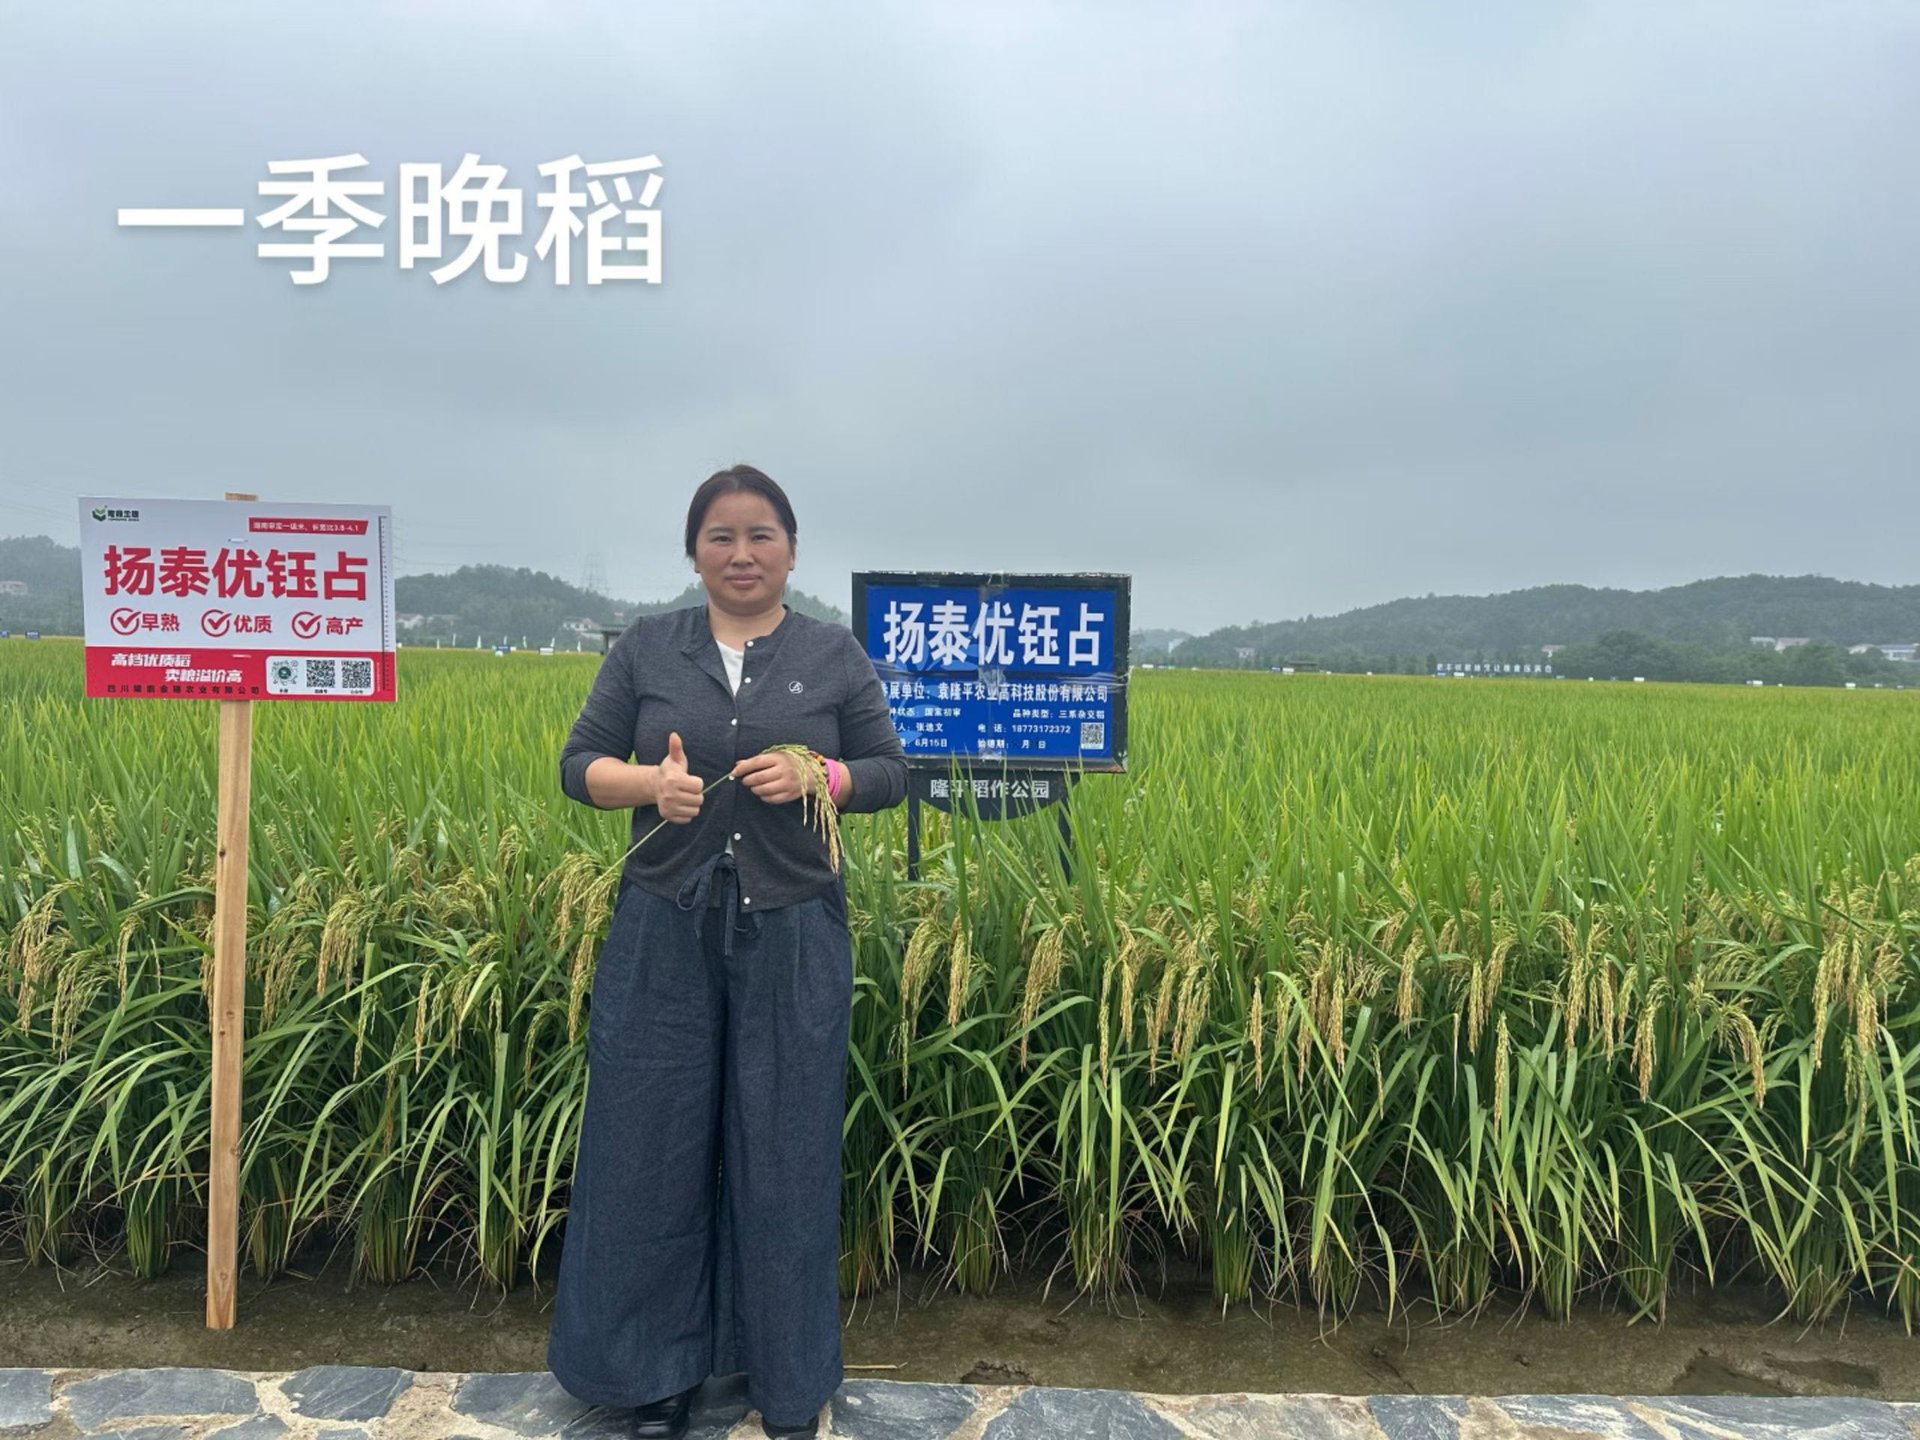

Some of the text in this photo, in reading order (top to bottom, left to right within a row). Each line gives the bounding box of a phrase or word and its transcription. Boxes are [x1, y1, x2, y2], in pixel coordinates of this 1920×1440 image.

[104, 545, 368, 601] 扬泰优钰占
[141, 612, 181, 632] 早熟
[233, 614, 272, 633] 优质
[325, 616, 364, 635] 高产
[883, 600, 1104, 666] 扬泰优钰占
[111, 653, 192, 667] 高档优质稻
